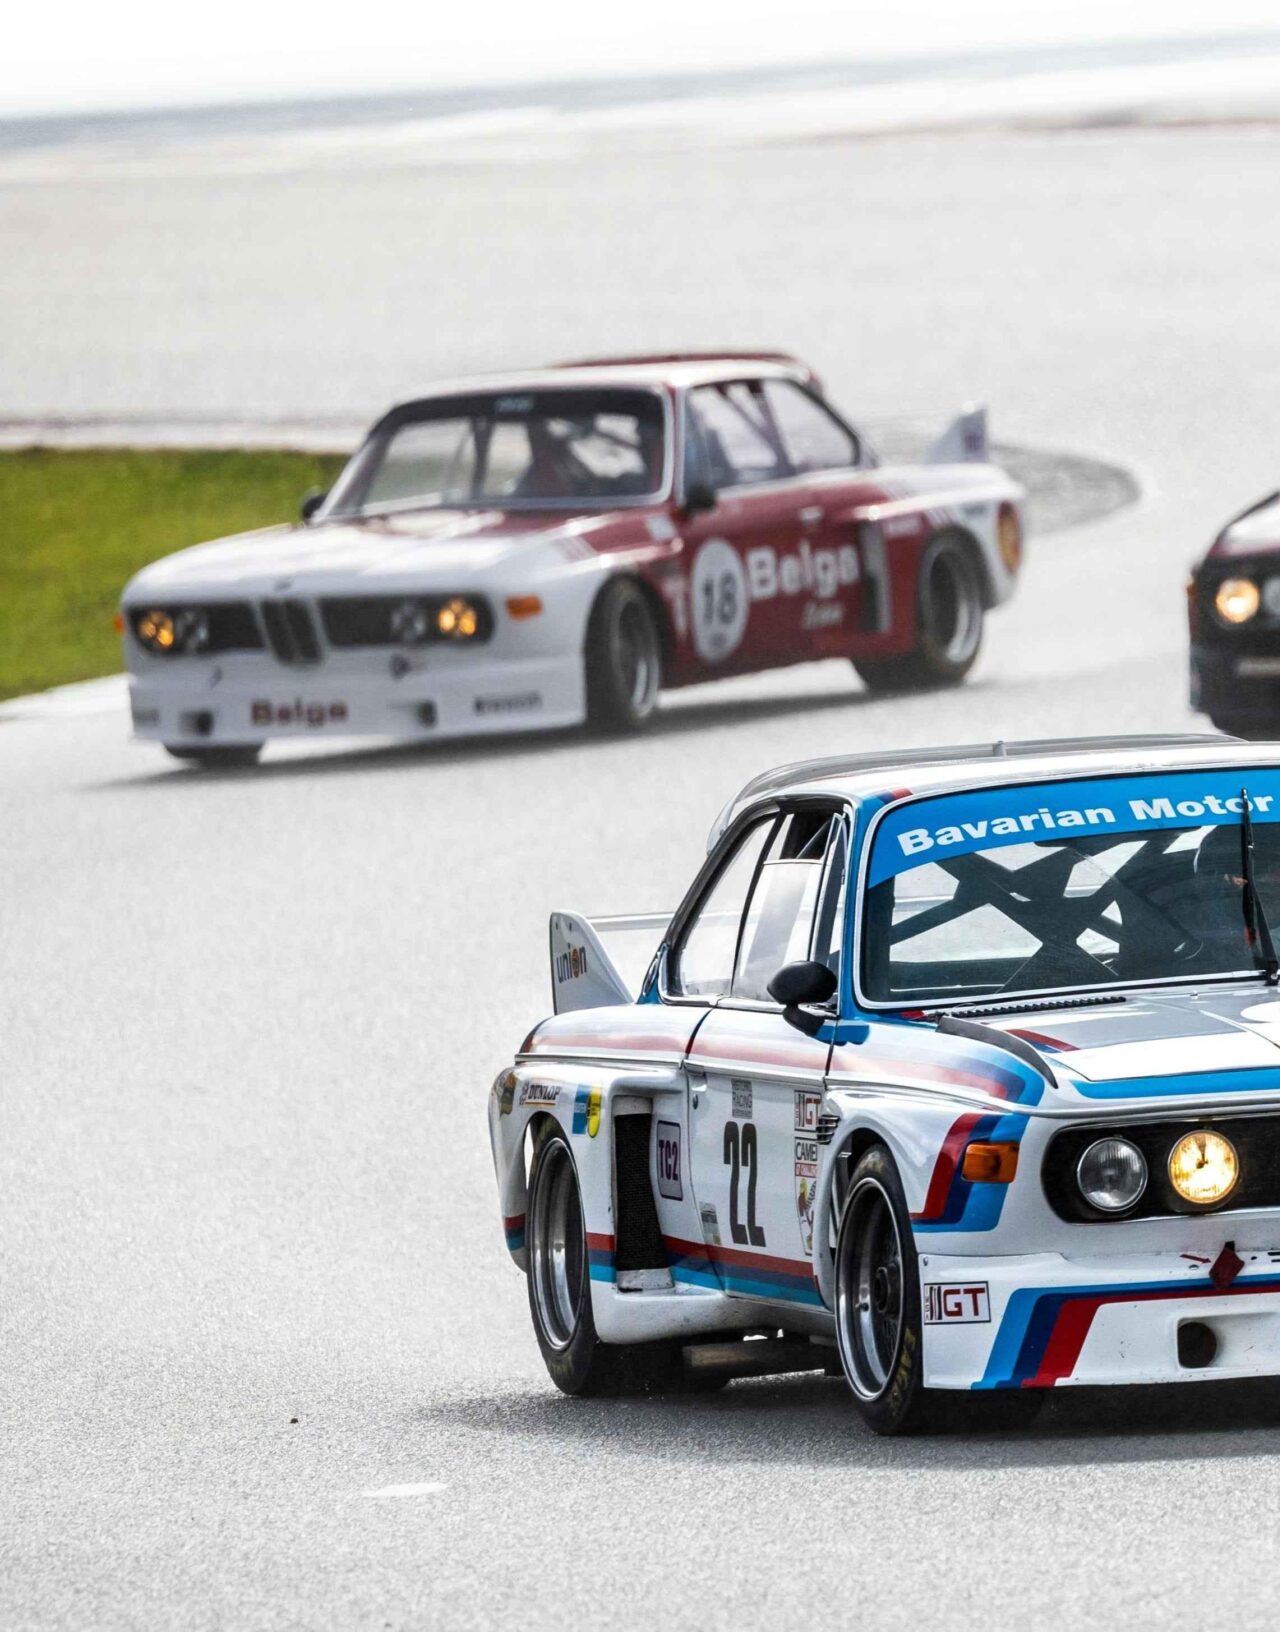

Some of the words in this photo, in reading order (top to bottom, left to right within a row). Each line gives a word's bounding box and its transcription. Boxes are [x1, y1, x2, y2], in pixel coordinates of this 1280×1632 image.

[702, 569, 737, 626] 18
[747, 540, 859, 600] Belga
[897, 808, 1116, 857] Bavarian
[1128, 794, 1274, 820] Motor
[556, 943, 587, 984] union
[528, 1084, 561, 1101] DUNLOP
[659, 1139, 679, 1181] TC2
[723, 1121, 767, 1247] 22
[943, 1287, 986, 1317] GT
